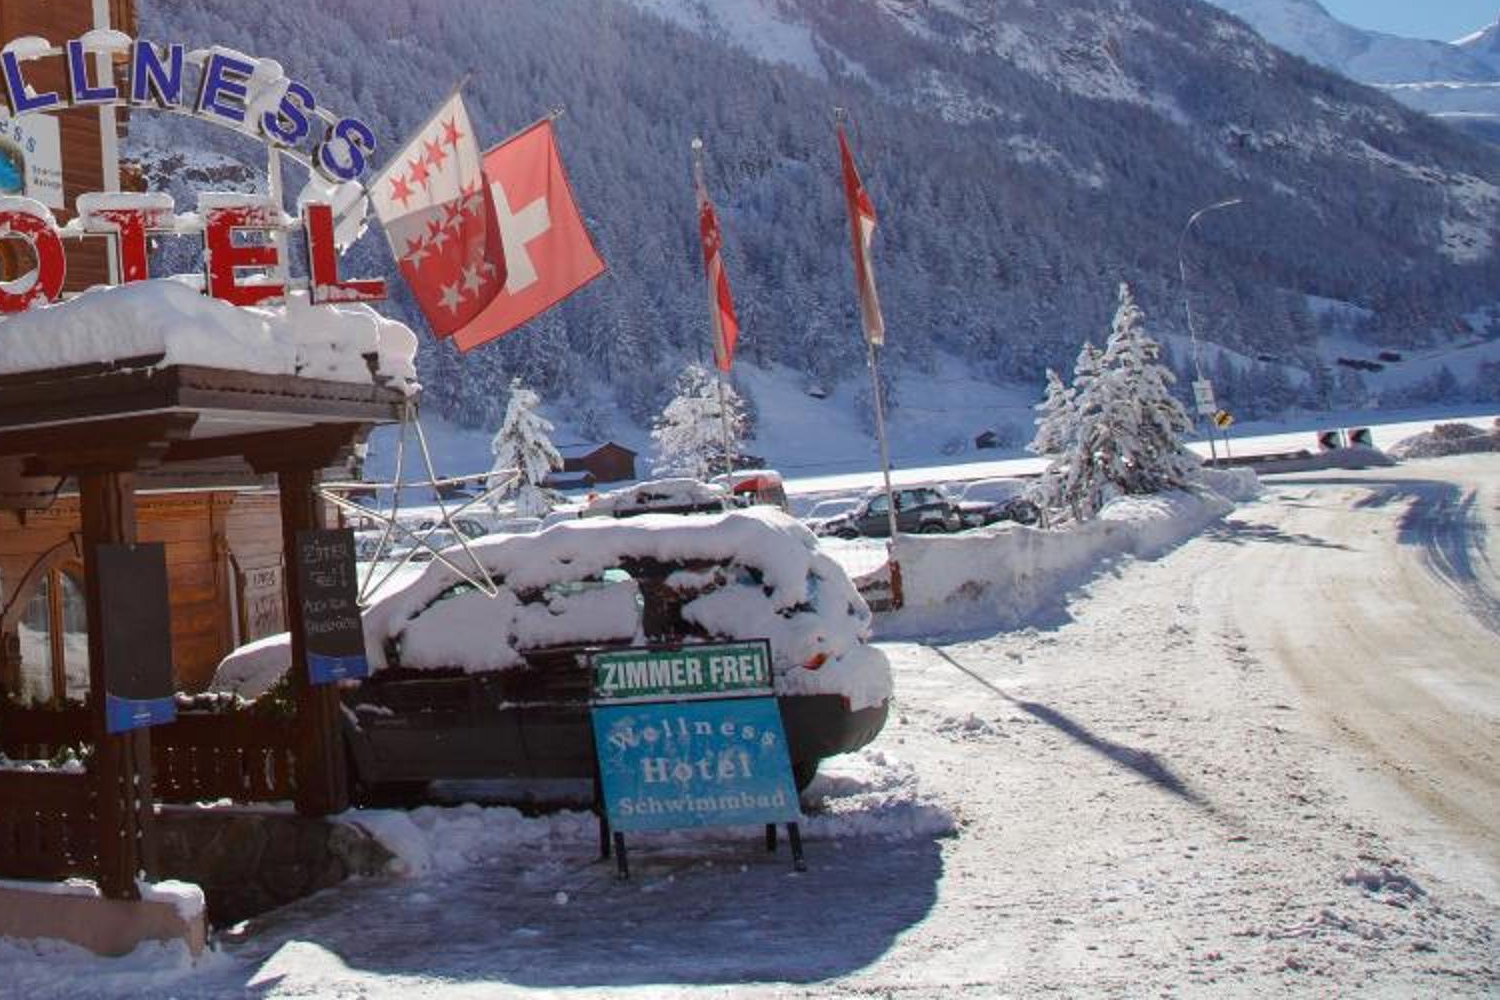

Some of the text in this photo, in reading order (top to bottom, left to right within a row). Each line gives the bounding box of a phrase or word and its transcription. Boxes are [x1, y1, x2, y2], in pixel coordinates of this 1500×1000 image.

[601, 653, 764, 690] ZIMMER FREI
[640, 750, 754, 784] Hotel
[618, 787, 786, 816] Schwimmbad
